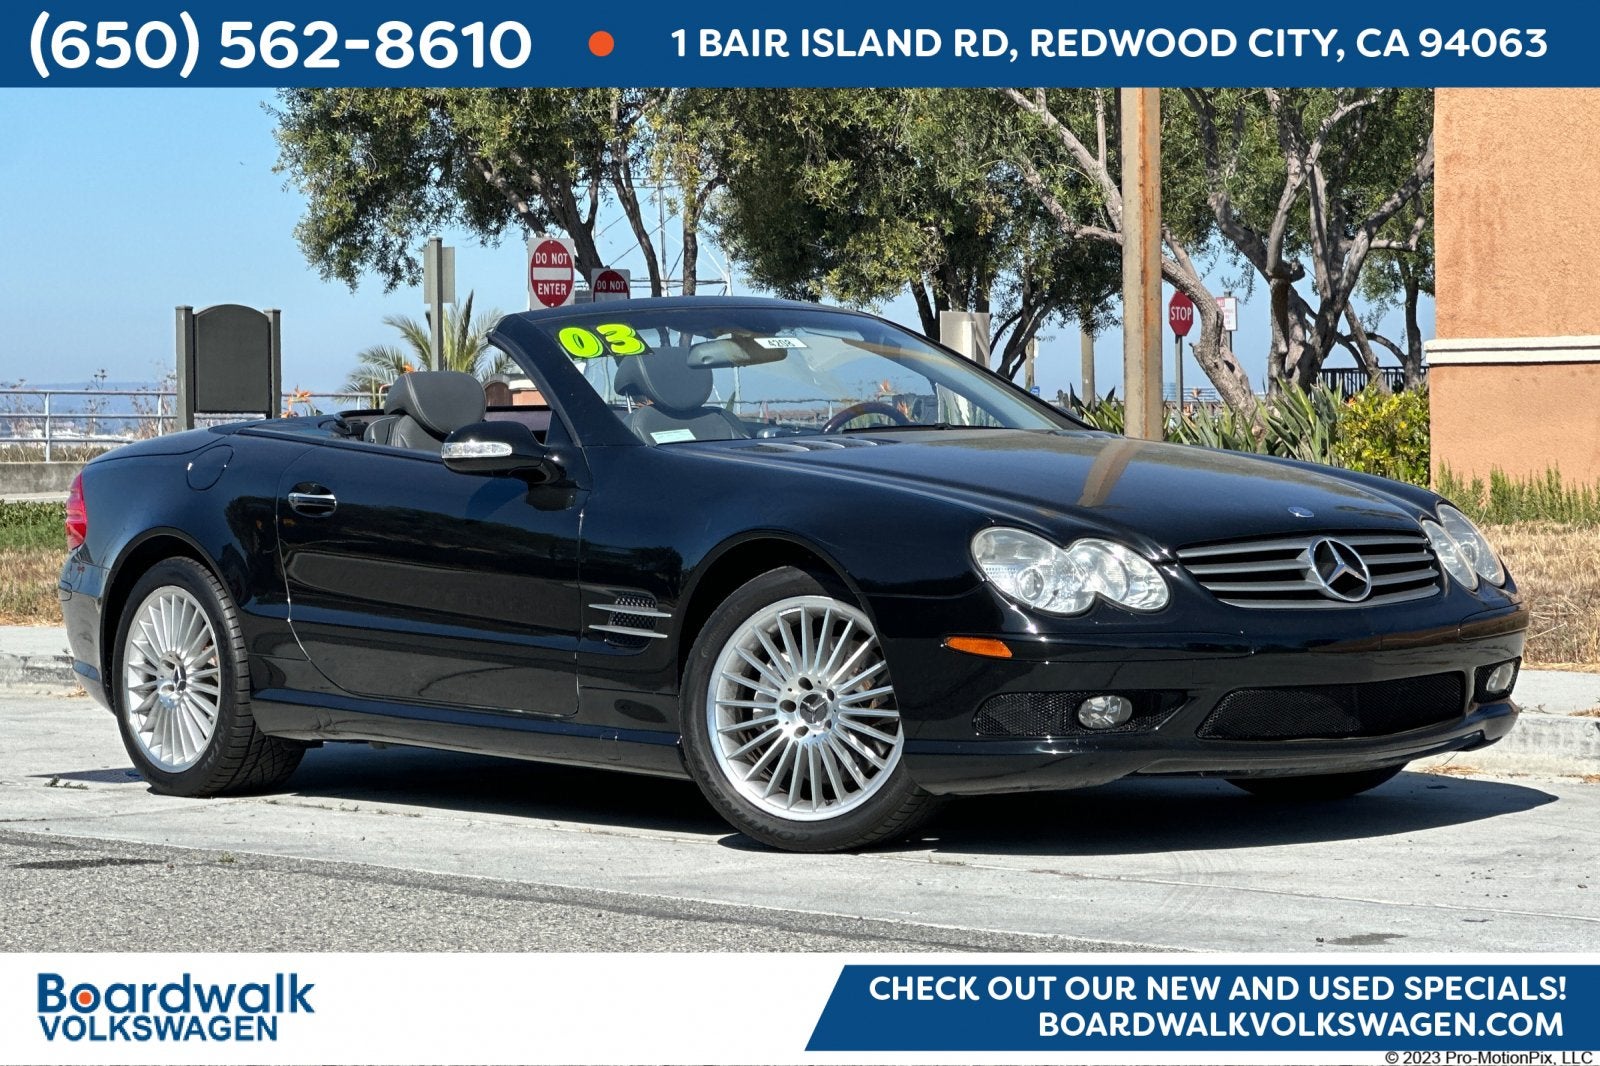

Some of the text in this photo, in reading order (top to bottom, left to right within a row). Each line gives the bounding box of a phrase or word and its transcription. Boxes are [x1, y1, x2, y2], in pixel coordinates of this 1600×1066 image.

[535, 252, 568, 265] DO NOT
[537, 283, 567, 295] ENTER
[596, 280, 625, 291] DO NOT
[1170, 306, 1192, 321] STOP
[558, 323, 646, 358] 03
